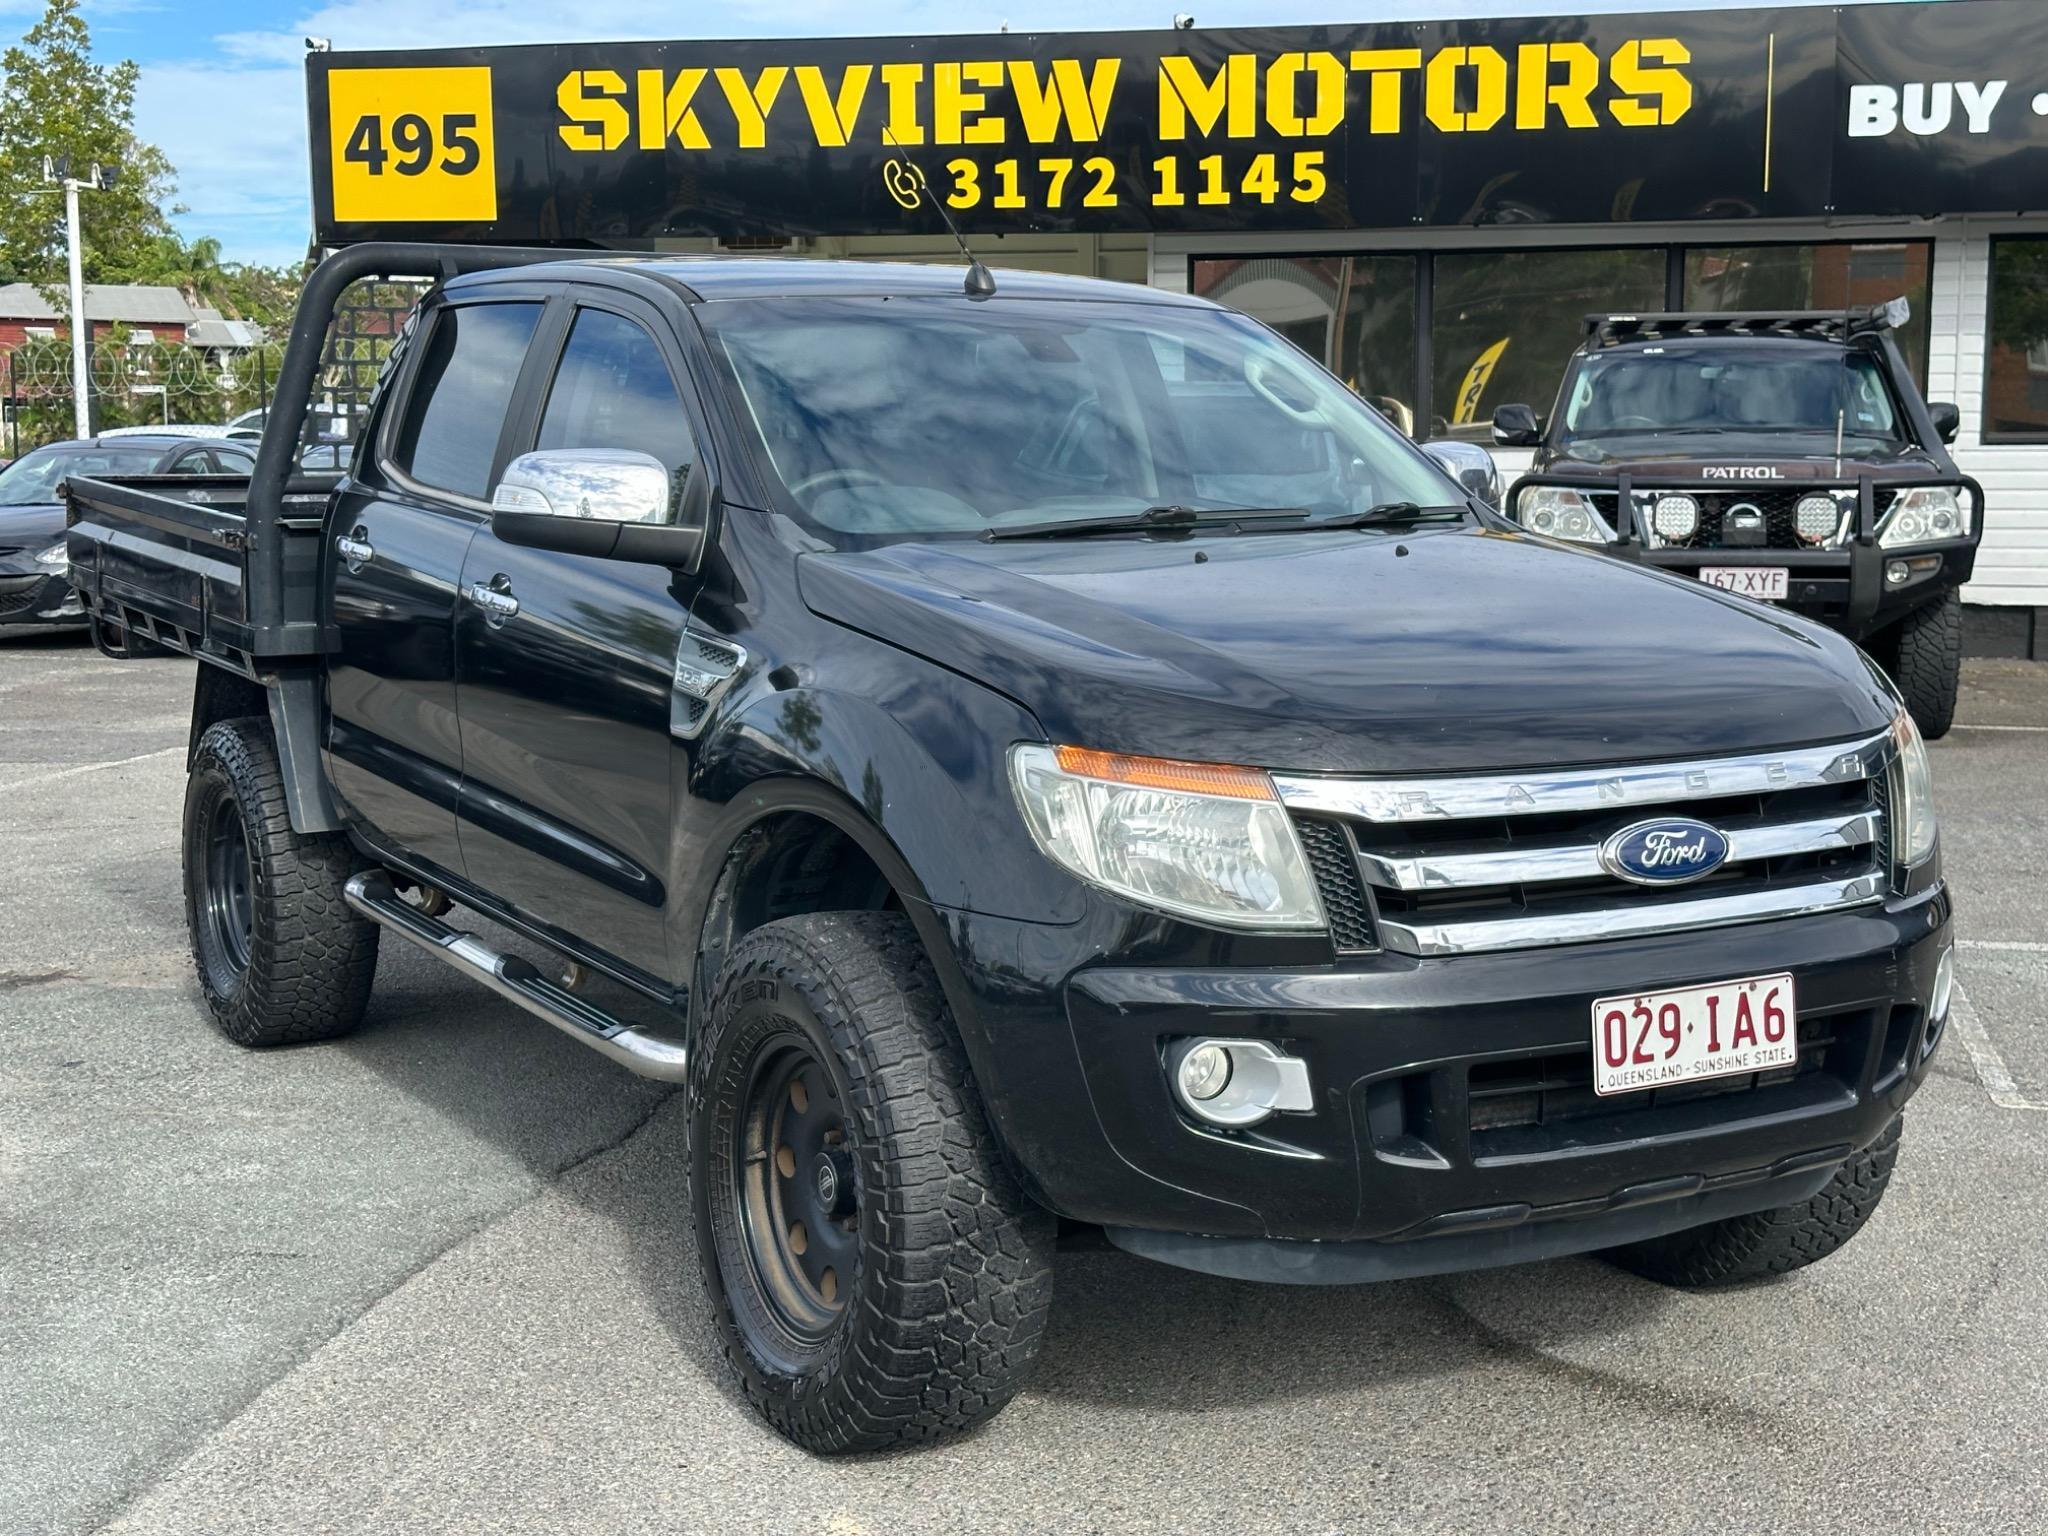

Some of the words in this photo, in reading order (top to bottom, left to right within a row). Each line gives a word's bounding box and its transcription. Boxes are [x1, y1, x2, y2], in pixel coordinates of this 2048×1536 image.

[557, 59, 1120, 151] SKYVIEW
[1158, 38, 1693, 140] MOTORS
[1848, 81, 2008, 137] BUY
[344, 114, 480, 176] 495
[946, 157, 1118, 209] 3172
[1153, 151, 1327, 206] 1145
[1701, 466, 1785, 479] PATROL
[1396, 754, 1866, 813] RANGER
[1641, 830, 1707, 868] Ford
[1608, 1064, 1683, 1087] QUEENSLAND
[1693, 1055, 1750, 1074] SUNSHINE
[1754, 1047, 1787, 1065] STATE
